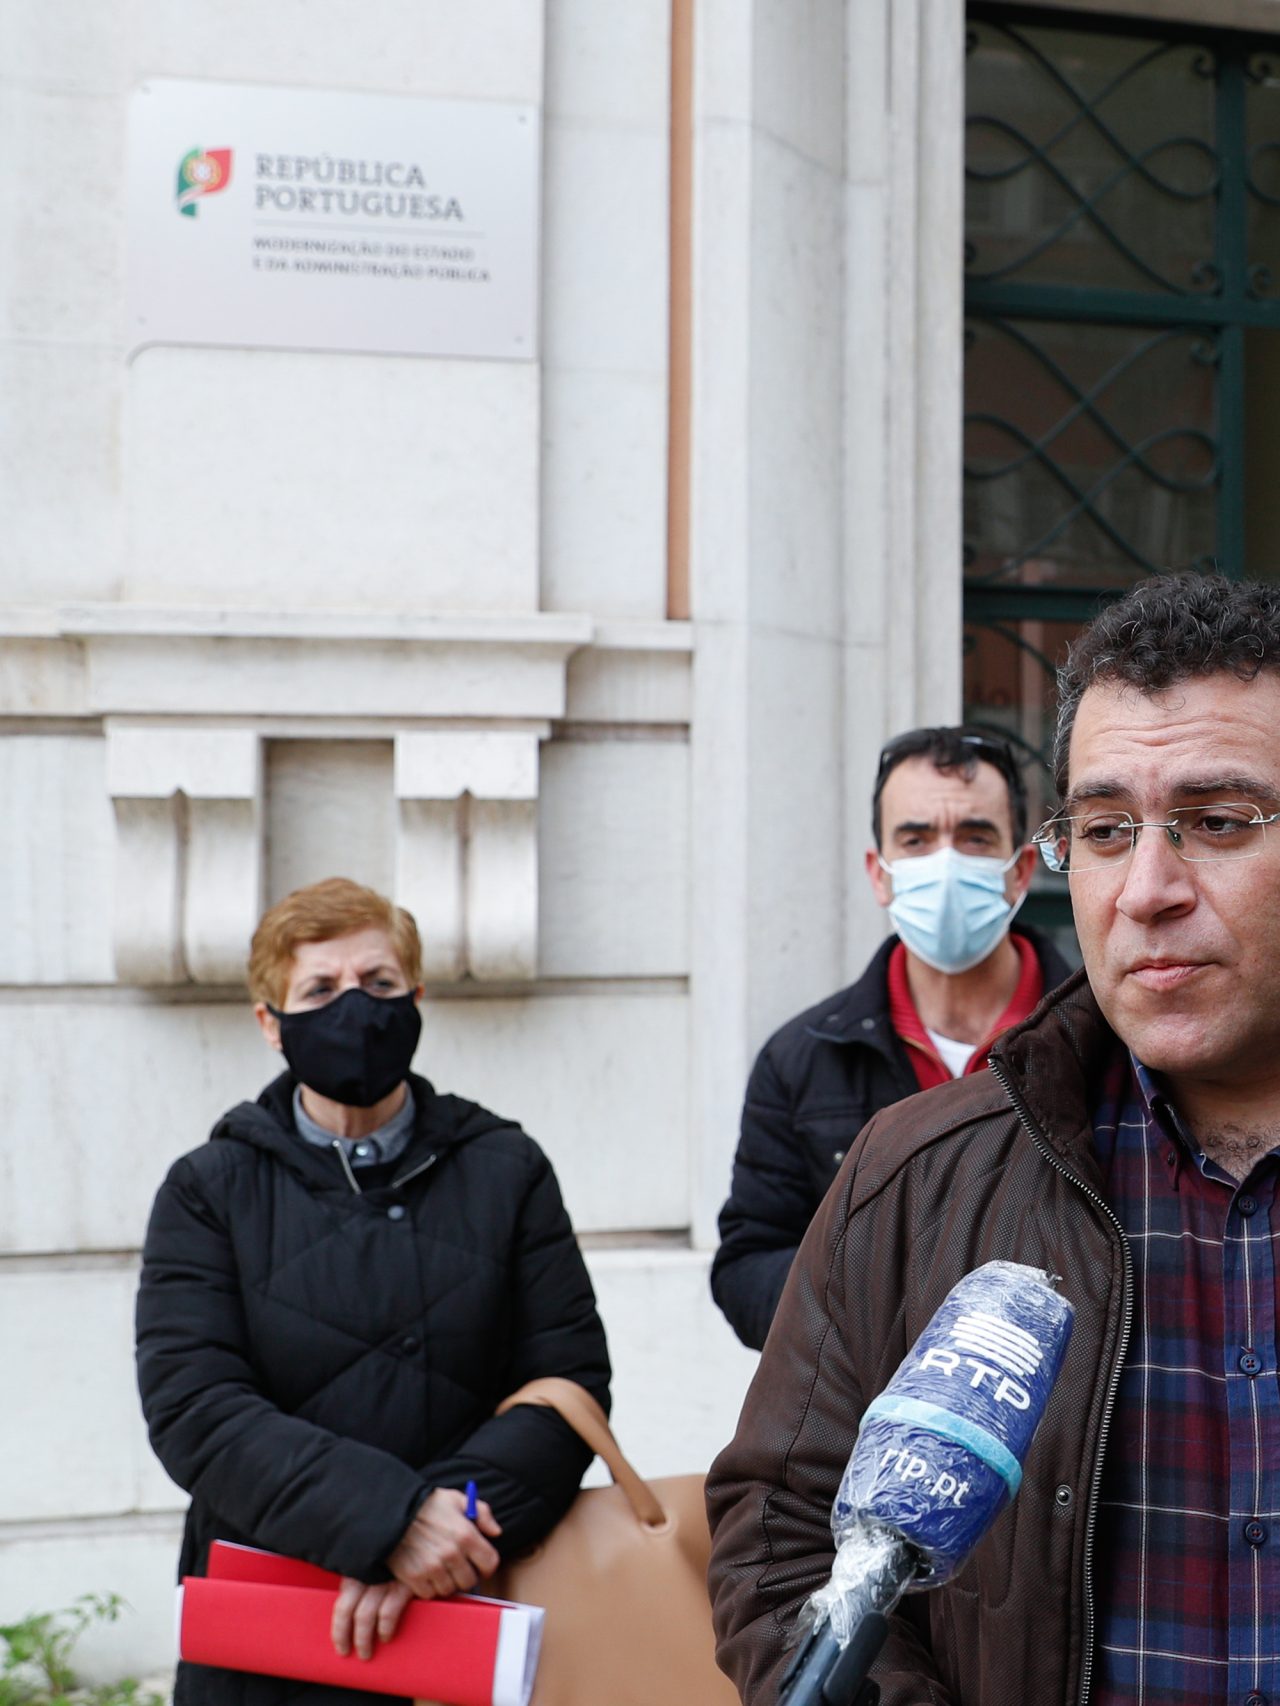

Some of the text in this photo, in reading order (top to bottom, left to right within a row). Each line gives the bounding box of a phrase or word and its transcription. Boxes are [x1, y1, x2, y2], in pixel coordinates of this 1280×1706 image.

[255, 151, 425, 190] REPÚBLICA
[255, 183, 465, 222] PORTUGUESA
[919, 1347, 1031, 1411] RTP
[880, 1445, 971, 1507] rtp.pt
